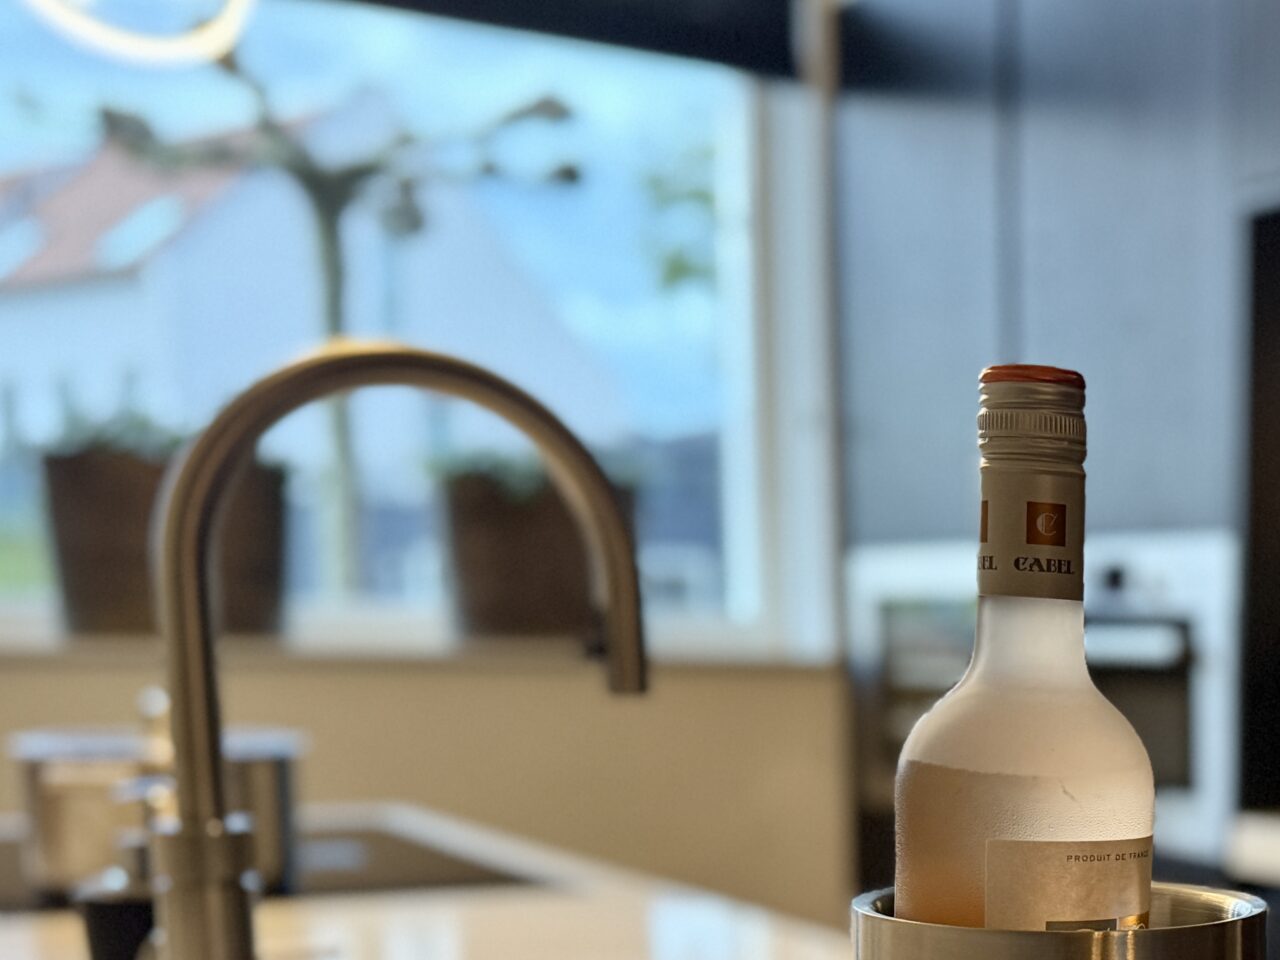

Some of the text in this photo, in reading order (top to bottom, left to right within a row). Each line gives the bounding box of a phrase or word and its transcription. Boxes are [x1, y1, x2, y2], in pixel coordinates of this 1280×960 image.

[1013, 556, 1076, 575] CABEL
[1066, 853, 1112, 863] PRODUIT
[1115, 852, 1127, 861] DE
